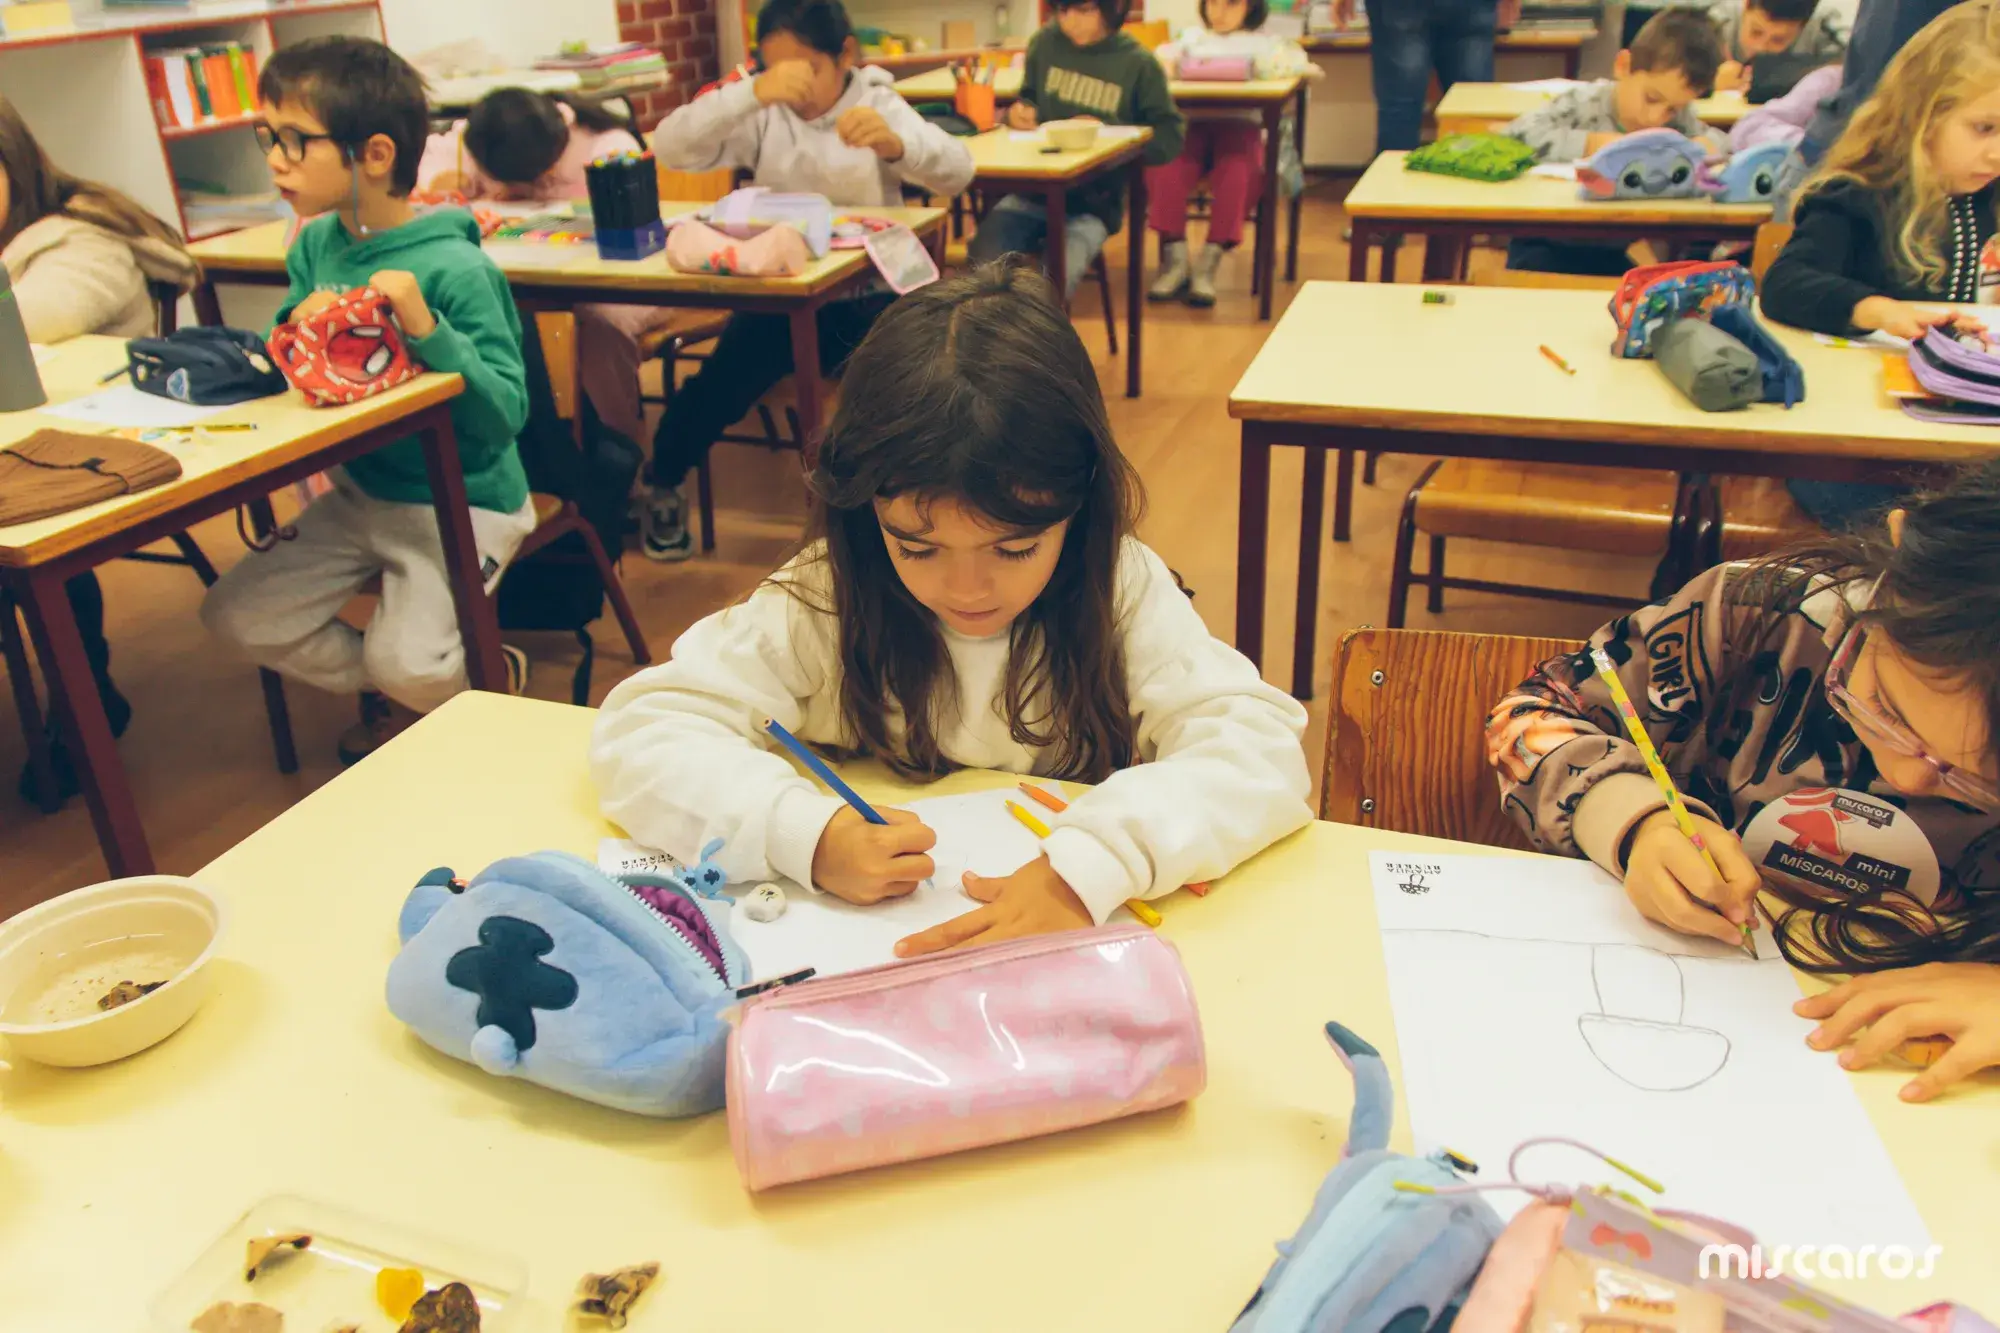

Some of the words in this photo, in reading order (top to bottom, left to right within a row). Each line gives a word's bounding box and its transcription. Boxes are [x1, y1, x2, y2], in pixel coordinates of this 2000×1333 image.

[1045, 66, 1122, 113] PUMA
[1650, 632, 1692, 707] GIRL
[1837, 797, 1890, 819] miscaros
[1856, 861, 1897, 881] mini
